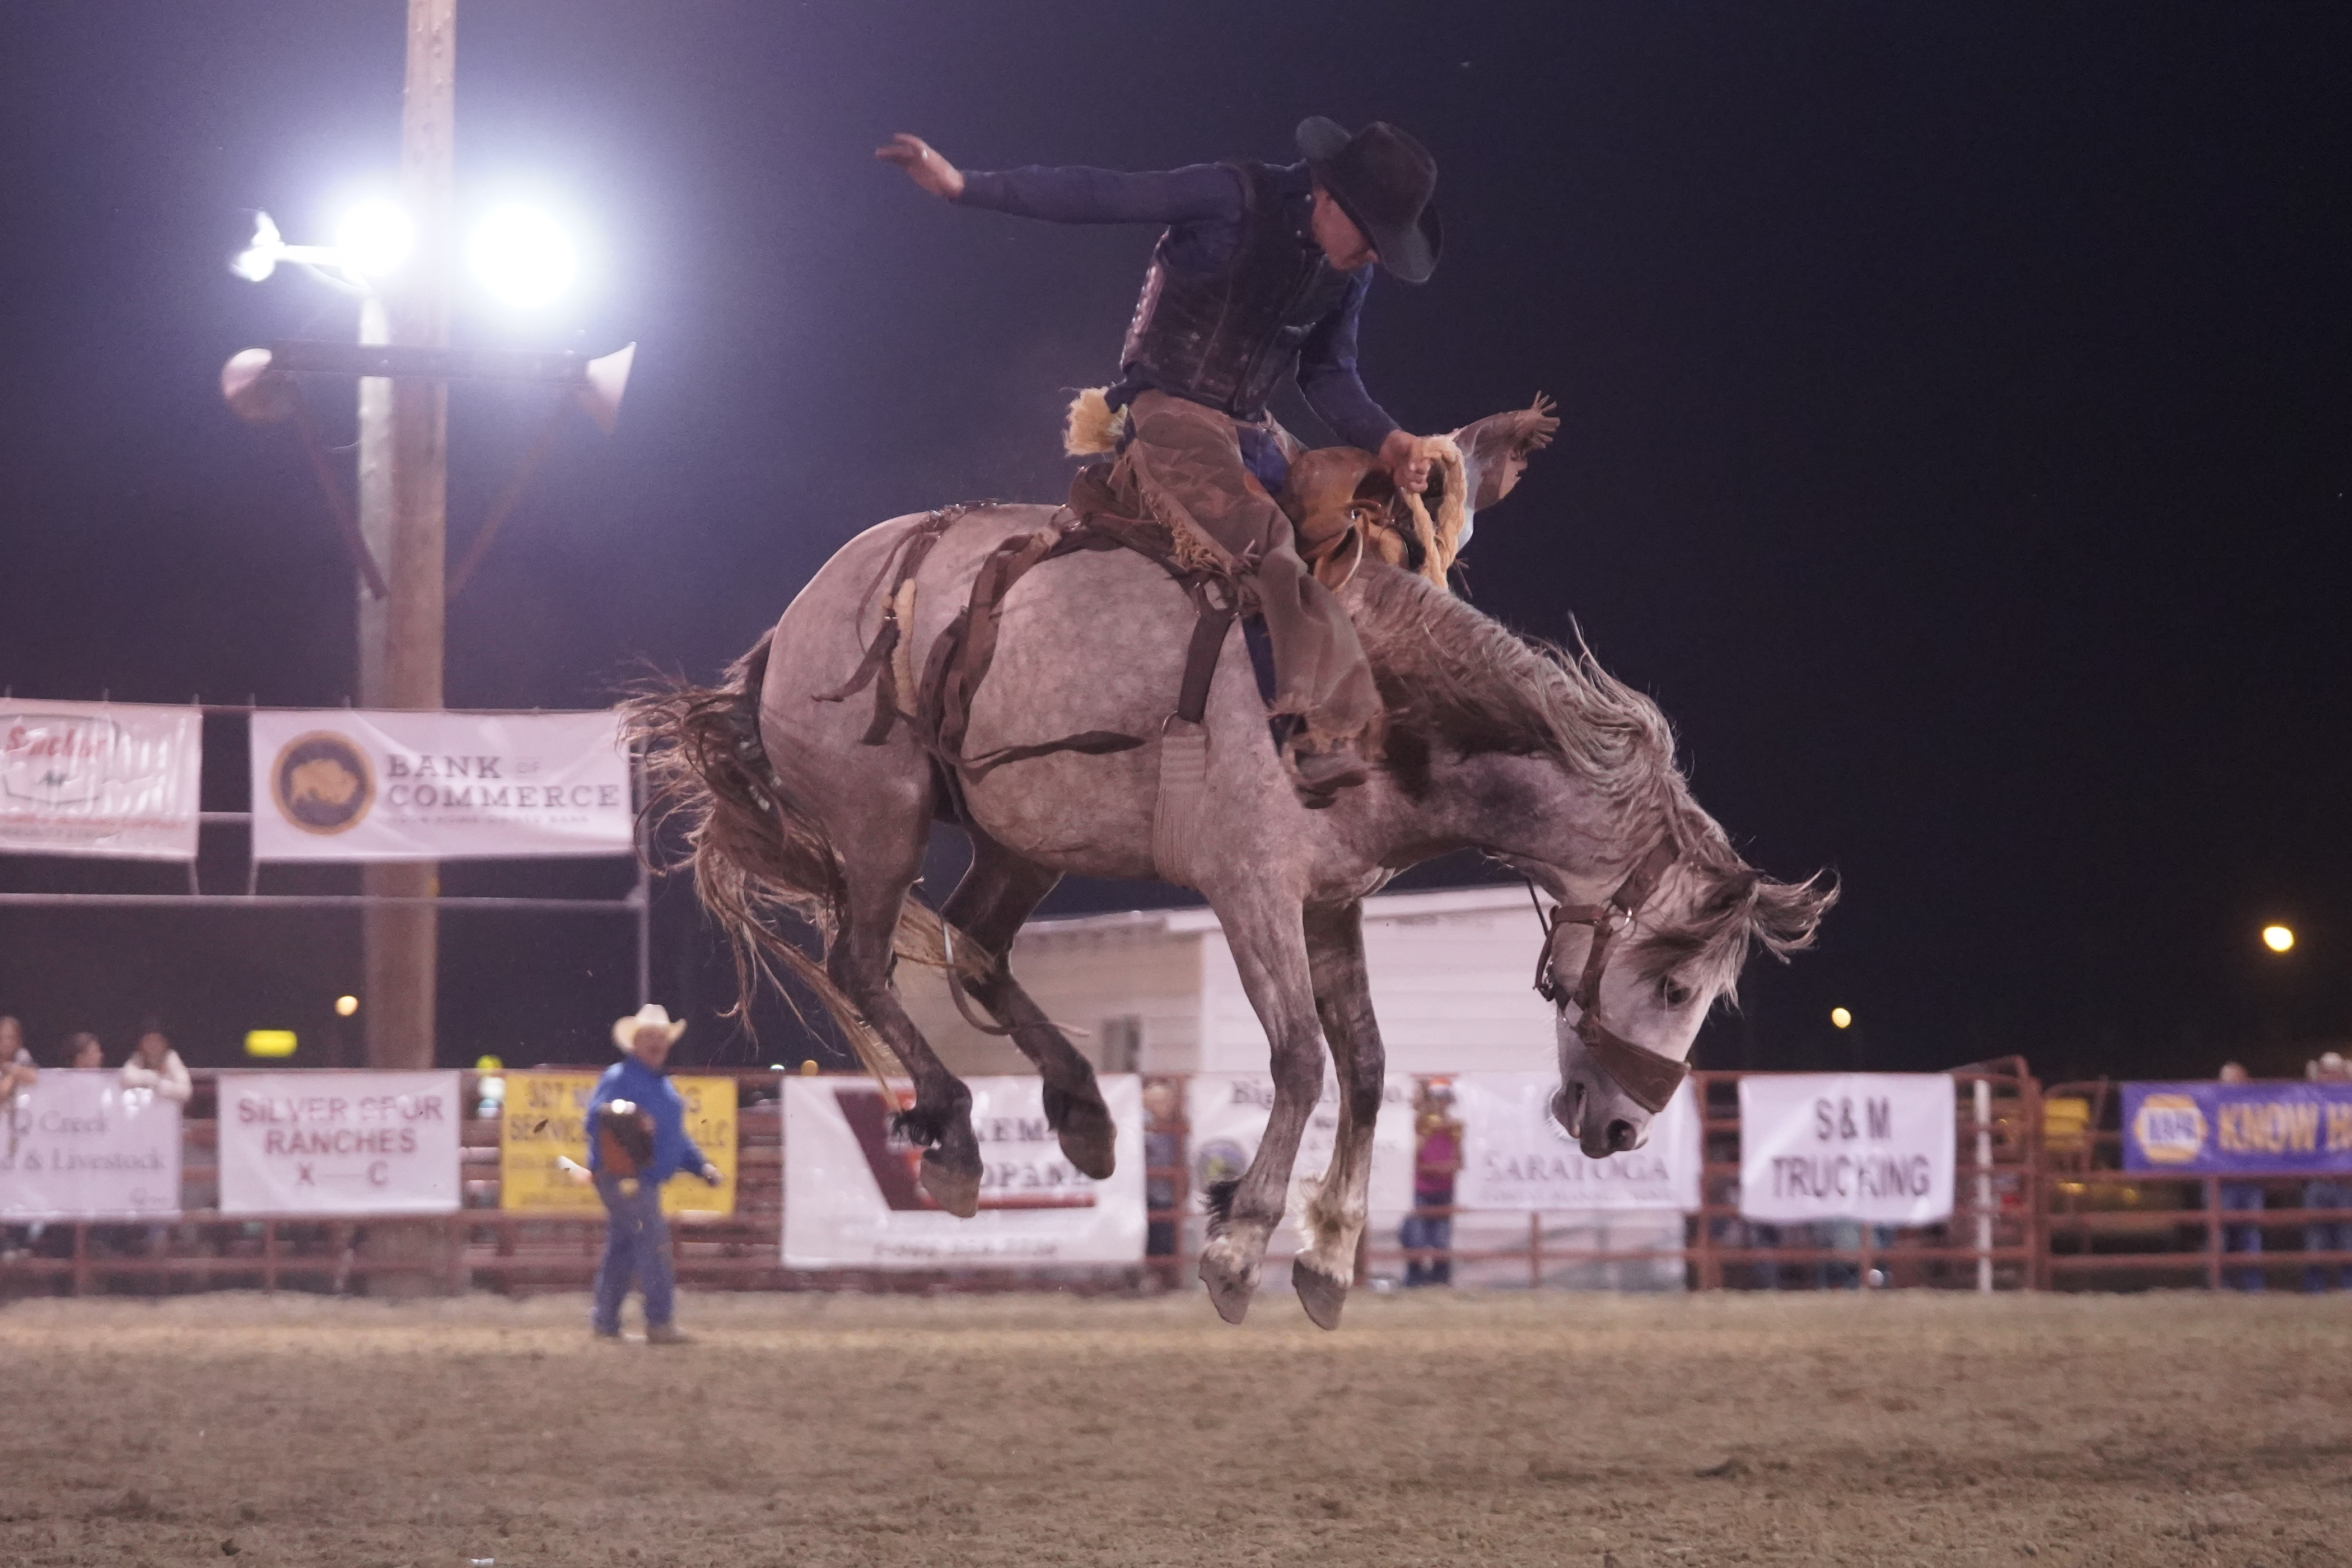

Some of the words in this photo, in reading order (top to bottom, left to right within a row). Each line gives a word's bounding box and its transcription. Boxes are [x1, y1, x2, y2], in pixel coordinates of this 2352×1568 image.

[388, 753, 502, 779] BANK
[387, 784, 619, 807] COMMERCE
[38, 1110, 109, 1133] Creek
[2218, 1102, 2319, 1154] KNOW
[264, 1127, 418, 1155] RANCHES
[54, 1147, 164, 1170] Livestock
[1485, 1150, 1670, 1180] SARATOGA
[1771, 1154, 1931, 1197] TRUCKING
